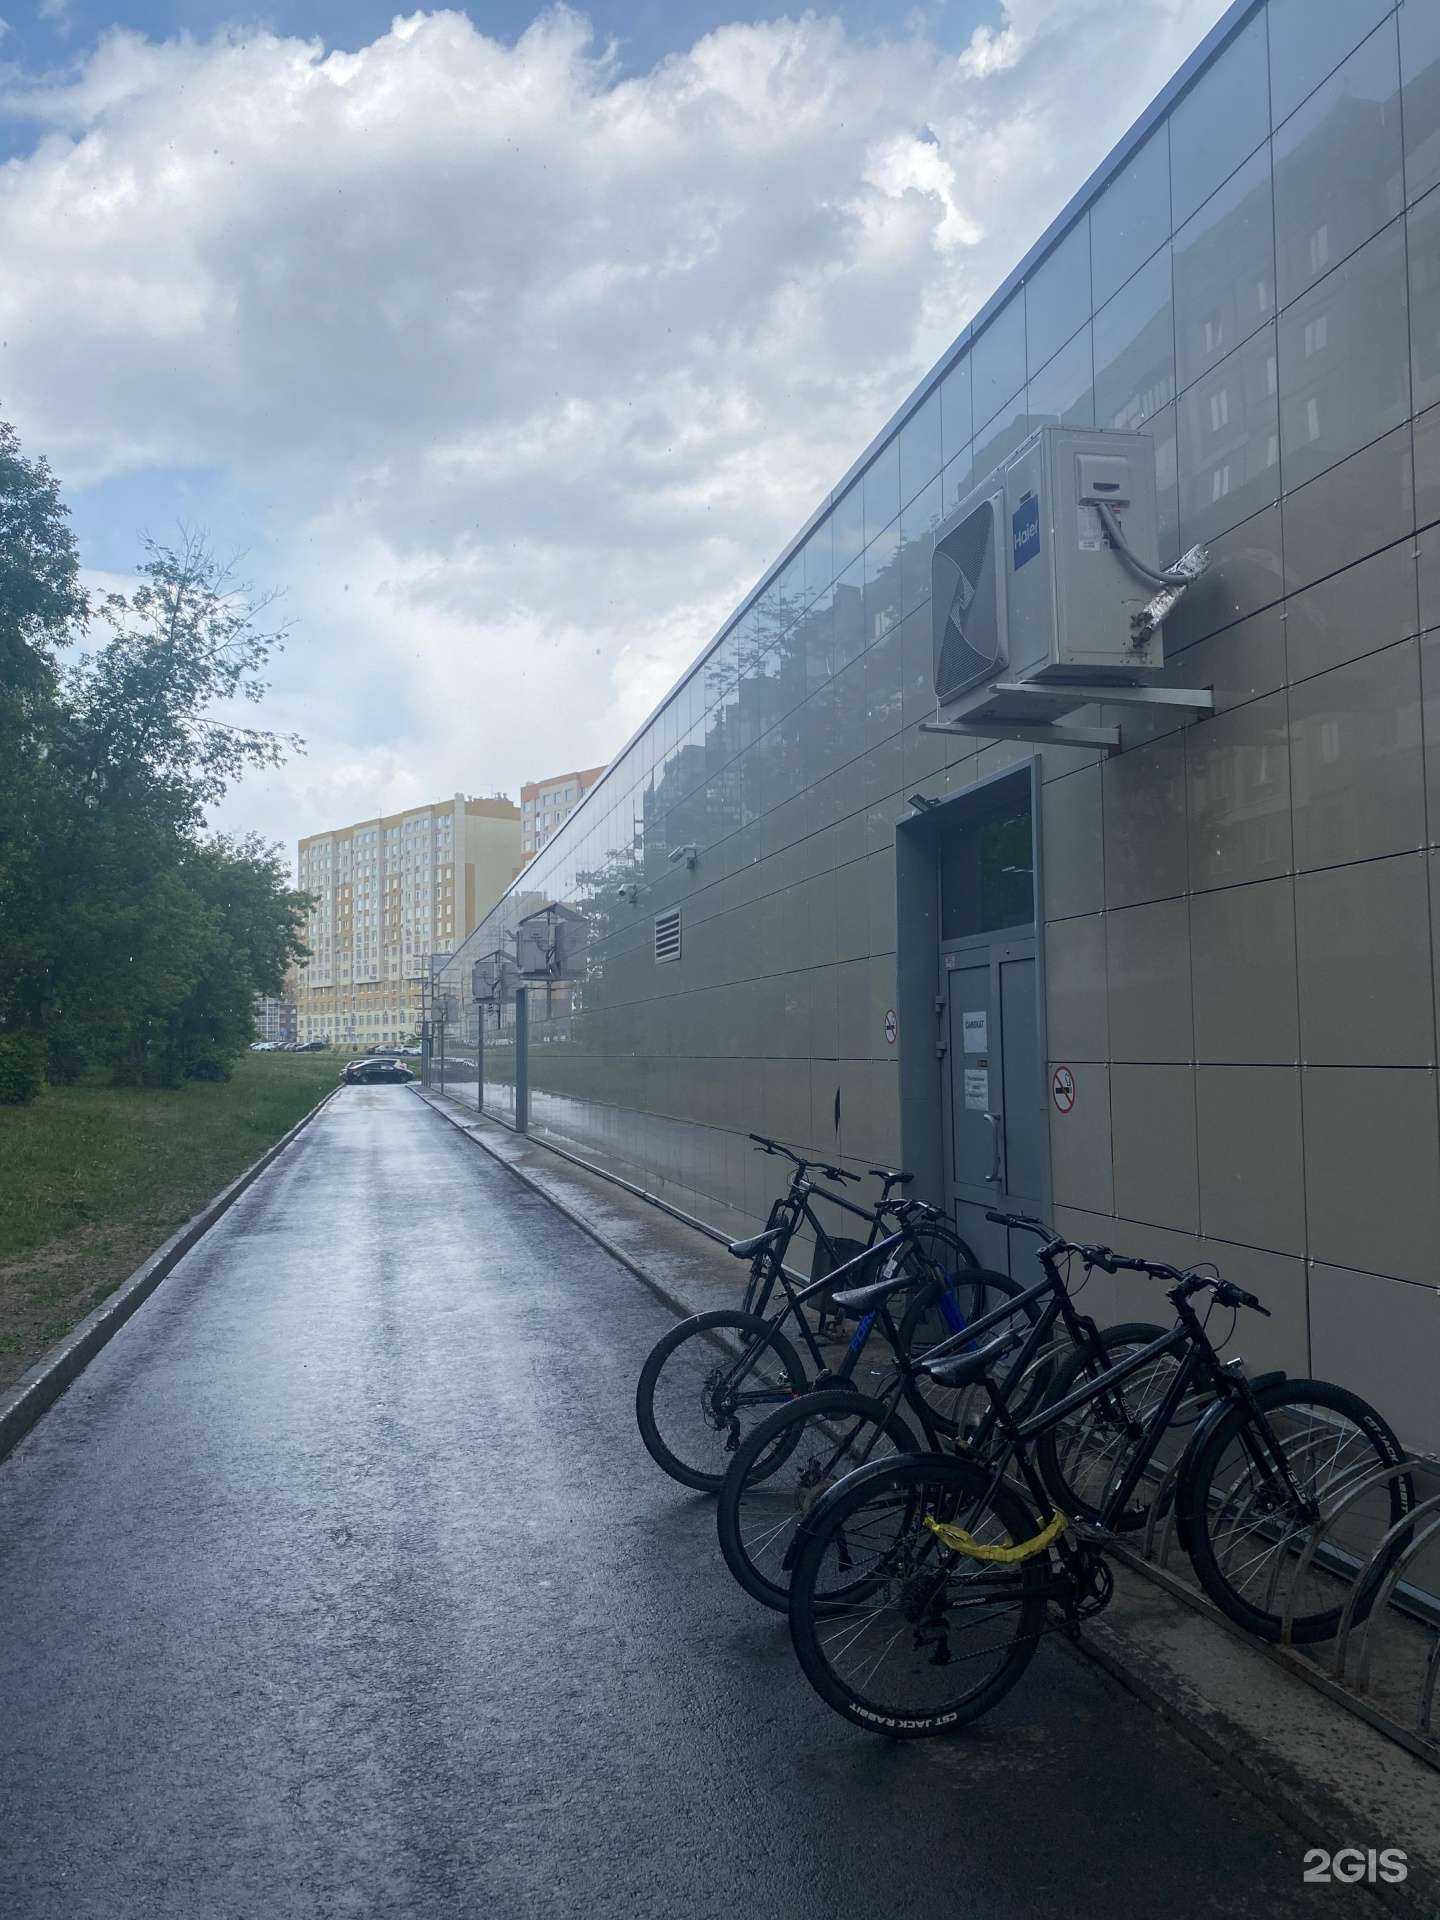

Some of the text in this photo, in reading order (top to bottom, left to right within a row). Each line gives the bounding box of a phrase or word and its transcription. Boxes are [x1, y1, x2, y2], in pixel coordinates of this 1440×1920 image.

[1014, 519, 1038, 551] Haier
[1378, 1431, 1399, 1464] JACK
[848, 1702, 957, 1729] CST JACK RABBIT
